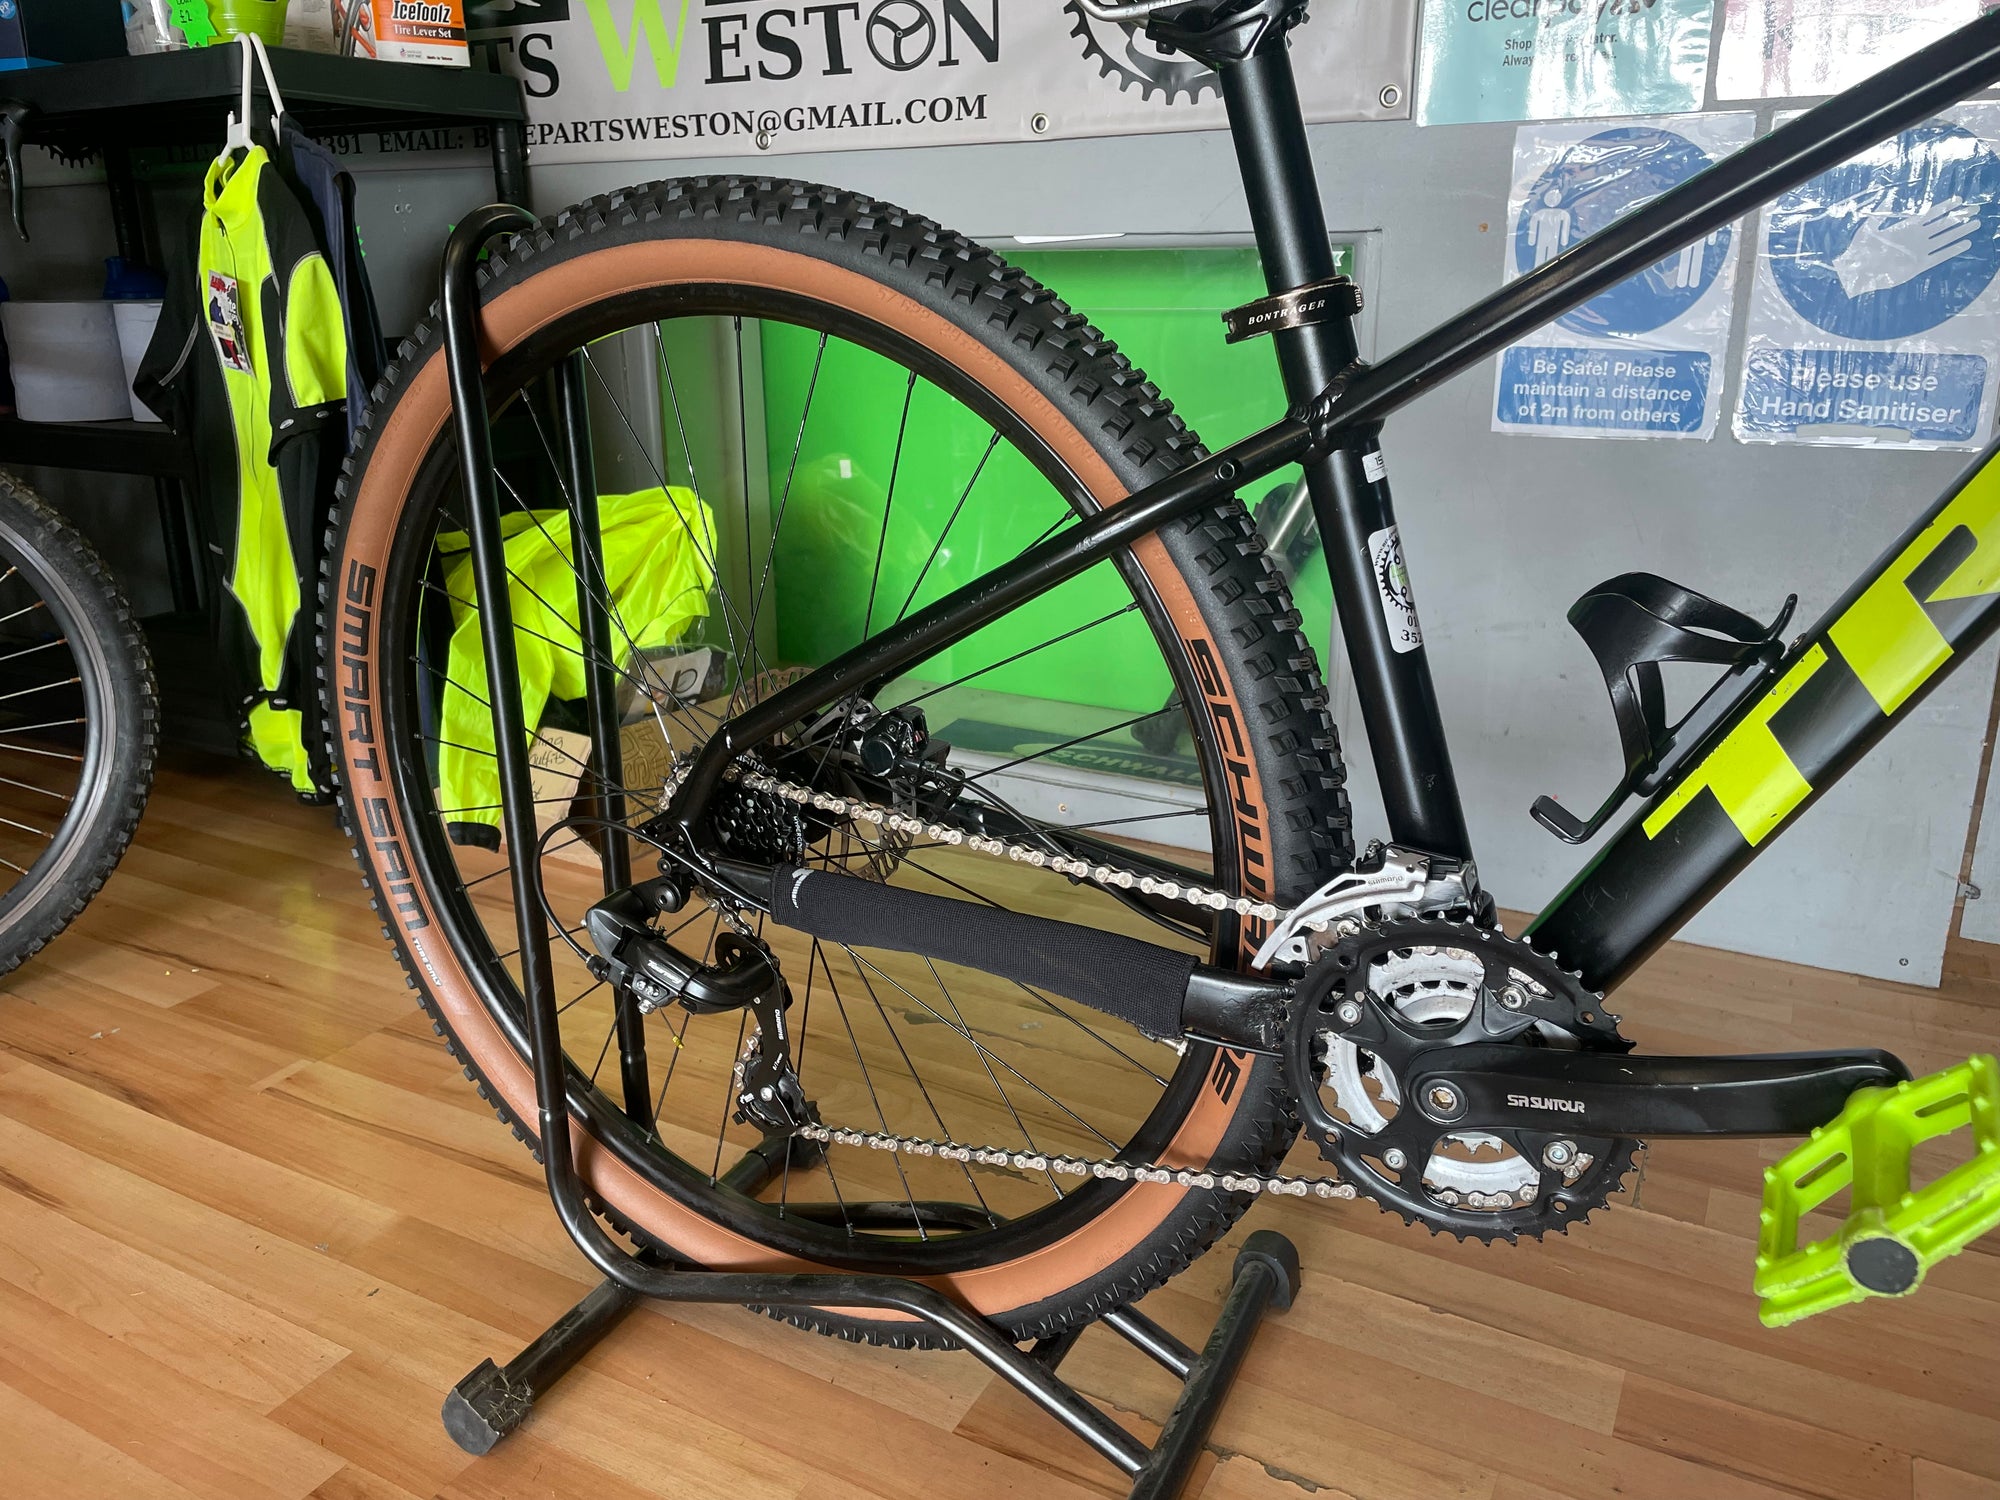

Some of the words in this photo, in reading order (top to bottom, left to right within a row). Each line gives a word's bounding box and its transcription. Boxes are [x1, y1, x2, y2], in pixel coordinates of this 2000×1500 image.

[392, 0, 451, 23] IceToolz
[393, 24, 411, 35] Tire
[413, 26, 437, 37] Lever
[438, 28, 452, 38] Set
[585, 0, 999, 92] WESTON
[1504, 38, 1532, 51] Shop
[1502, 53, 1535, 67] Alway
[378, 128, 464, 154] EMAIL:
[473, 94, 988, 149] BEPARTSWESTON@GMAIL.COM
[1248, 300, 1326, 325] BONTRAGER
[1533, 359, 1557, 375] Be
[1562, 360, 1609, 376] Safe!
[1614, 361, 1677, 379] Please
[1792, 366, 1881, 391] Please
[1888, 373, 1939, 391] use
[1513, 382, 1590, 398] maintain
[1595, 386, 1606, 398] a
[1612, 385, 1692, 401] distance
[1518, 402, 1537, 417] of
[1540, 403, 1568, 418] 2m
[1572, 404, 1616, 420] from
[1621, 408, 1681, 424] others
[1761, 396, 1831, 418] Hand
[1839, 398, 1961, 423] Sanitiser
[342, 558, 382, 783] SMART
[362, 797, 429, 931] SAM
[412, 937, 428, 963] TUBE
[425, 963, 442, 986] ONLY
[1530, 1096, 1585, 1113] SUNTOUR
